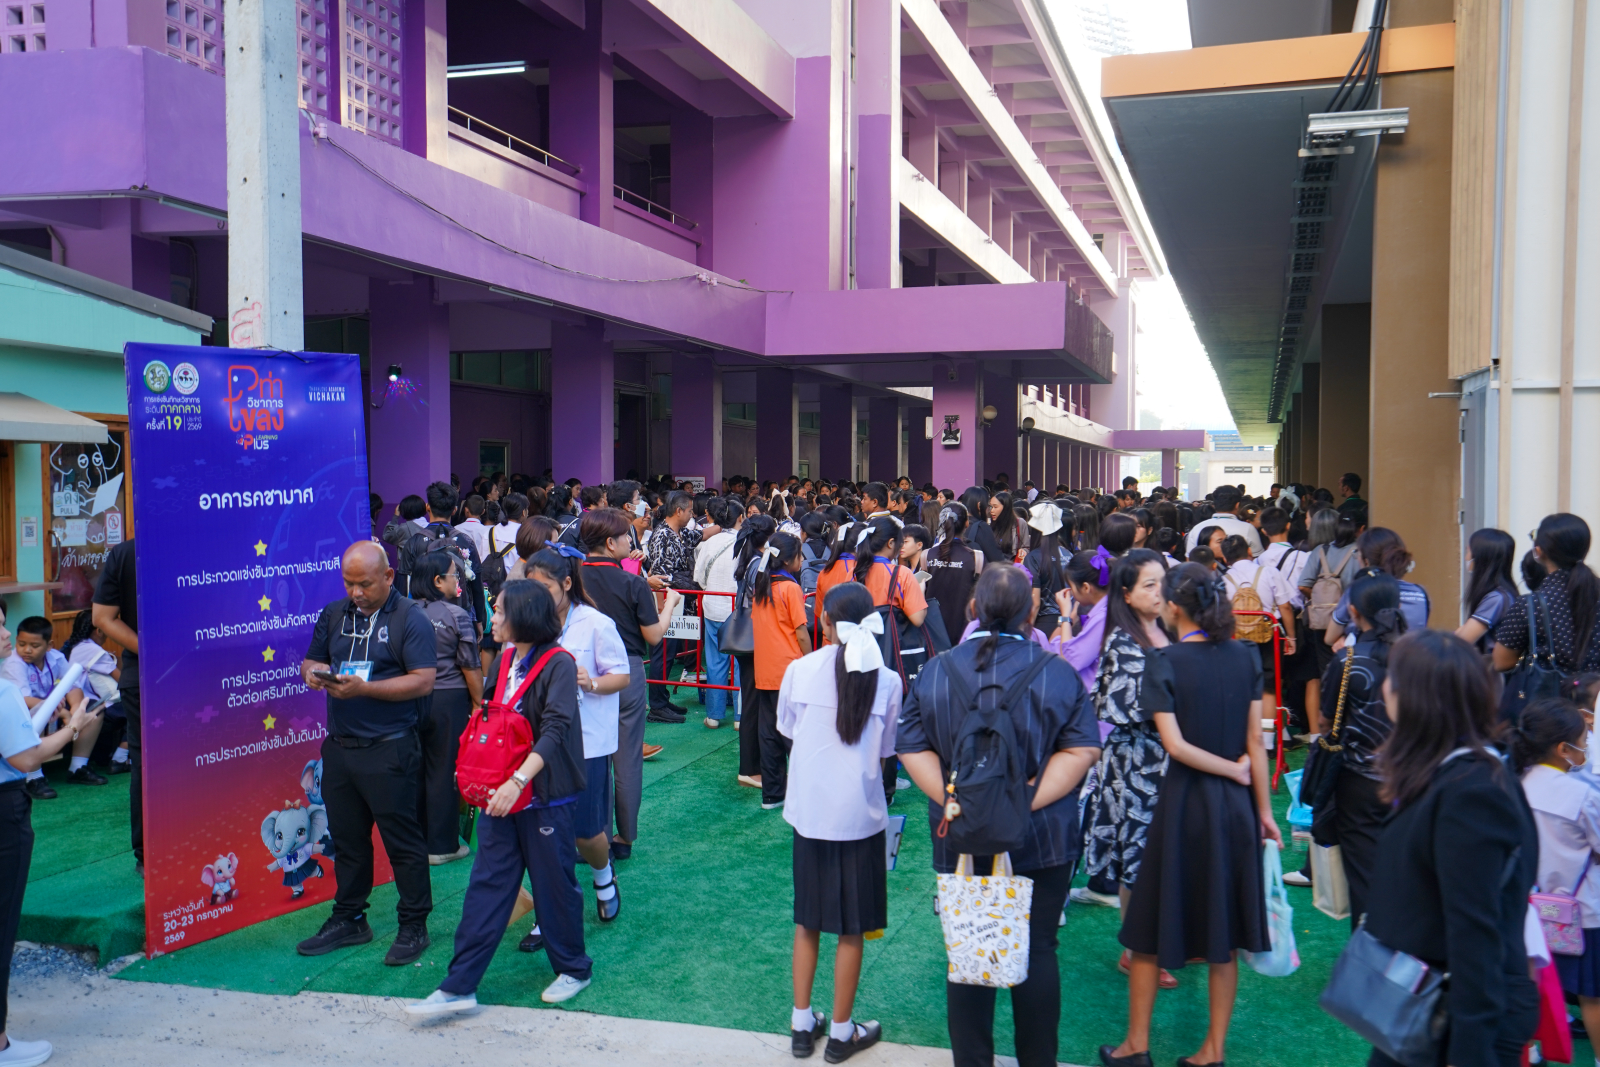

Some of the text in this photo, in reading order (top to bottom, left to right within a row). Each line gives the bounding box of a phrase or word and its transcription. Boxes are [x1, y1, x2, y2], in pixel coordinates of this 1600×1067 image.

[247, 396, 284, 408] วิชาการ
[308, 391, 346, 401] VICHAKAN
[146, 415, 183, 430] ครั้งที่ 19
[187, 422, 203, 431] 2569
[60, 507, 74, 515] PULL
[177, 555, 341, 588] การประกวดแข่งขันวาดภาพระบายสี
[222, 661, 303, 690] การประกวดแข่ง
[227, 682, 309, 708] ตัวต่อเสริมทักษะ
[195, 721, 330, 767] การประกวดแข่งขันปั้นดินน้ำ
[163, 897, 204, 919] ระหว่างวันที่
[163, 904, 233, 932] 20-23 กรกฎาคม
[976, 920, 1000, 933] GOOD
[164, 931, 185, 944] 2569
[977, 931, 998, 943] TIME
